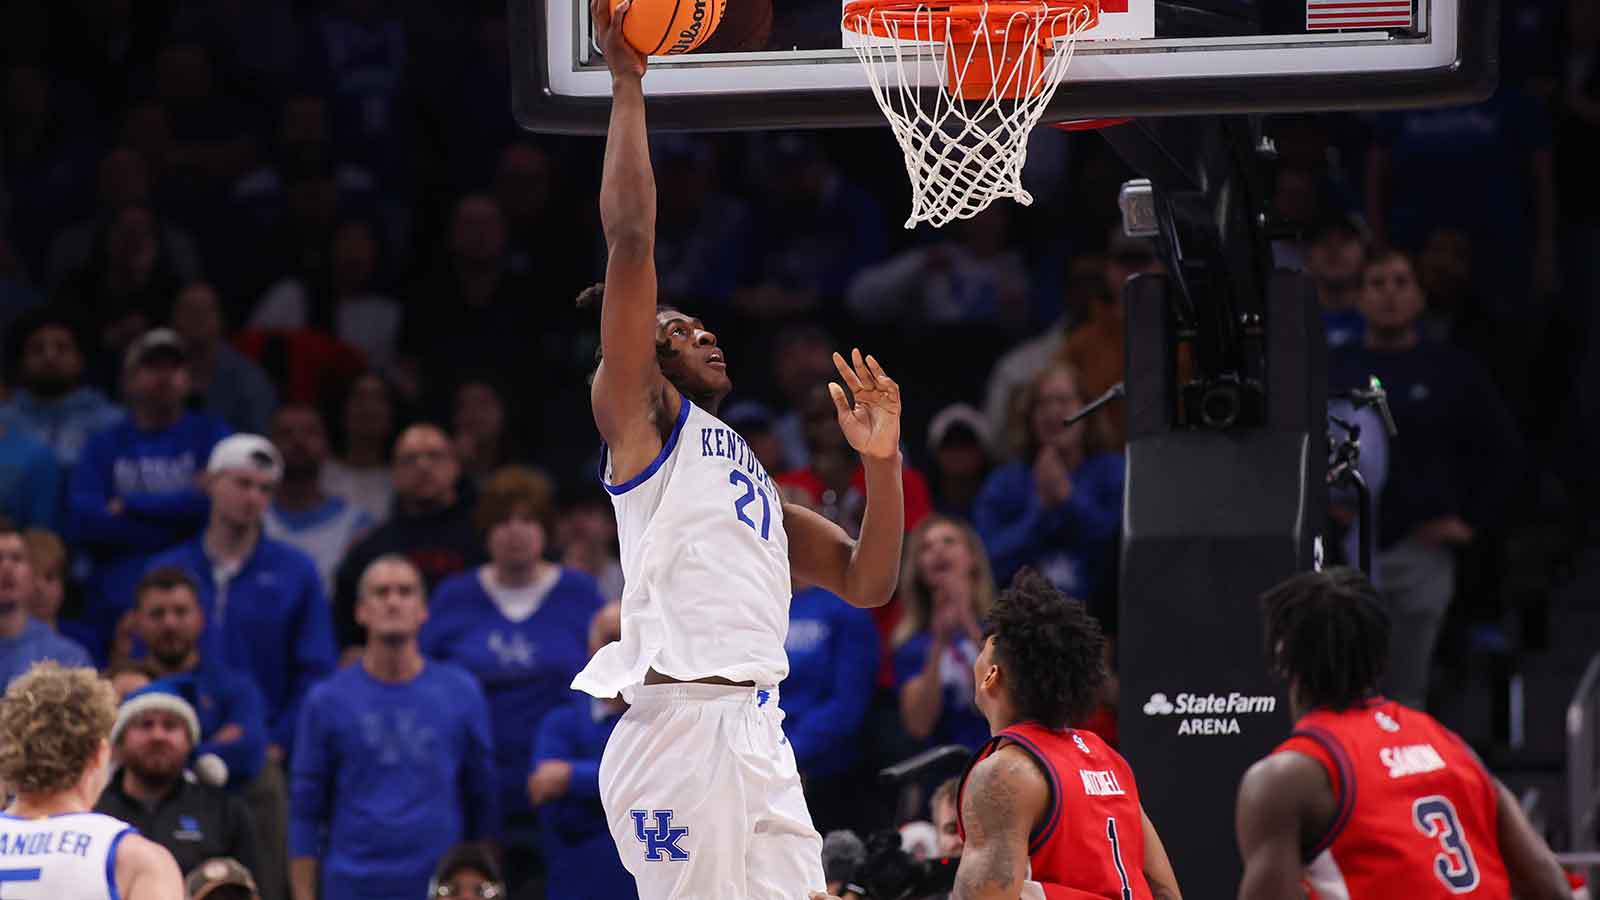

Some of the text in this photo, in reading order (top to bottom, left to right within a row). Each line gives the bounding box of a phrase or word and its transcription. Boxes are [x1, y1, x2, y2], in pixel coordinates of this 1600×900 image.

[701, 428, 777, 501] KENTUC
[729, 469, 771, 541] 21
[1178, 718, 1241, 735] ARENA
[630, 809, 690, 862] UK
[1106, 816, 1133, 900] 1
[1411, 794, 1481, 895] 3
